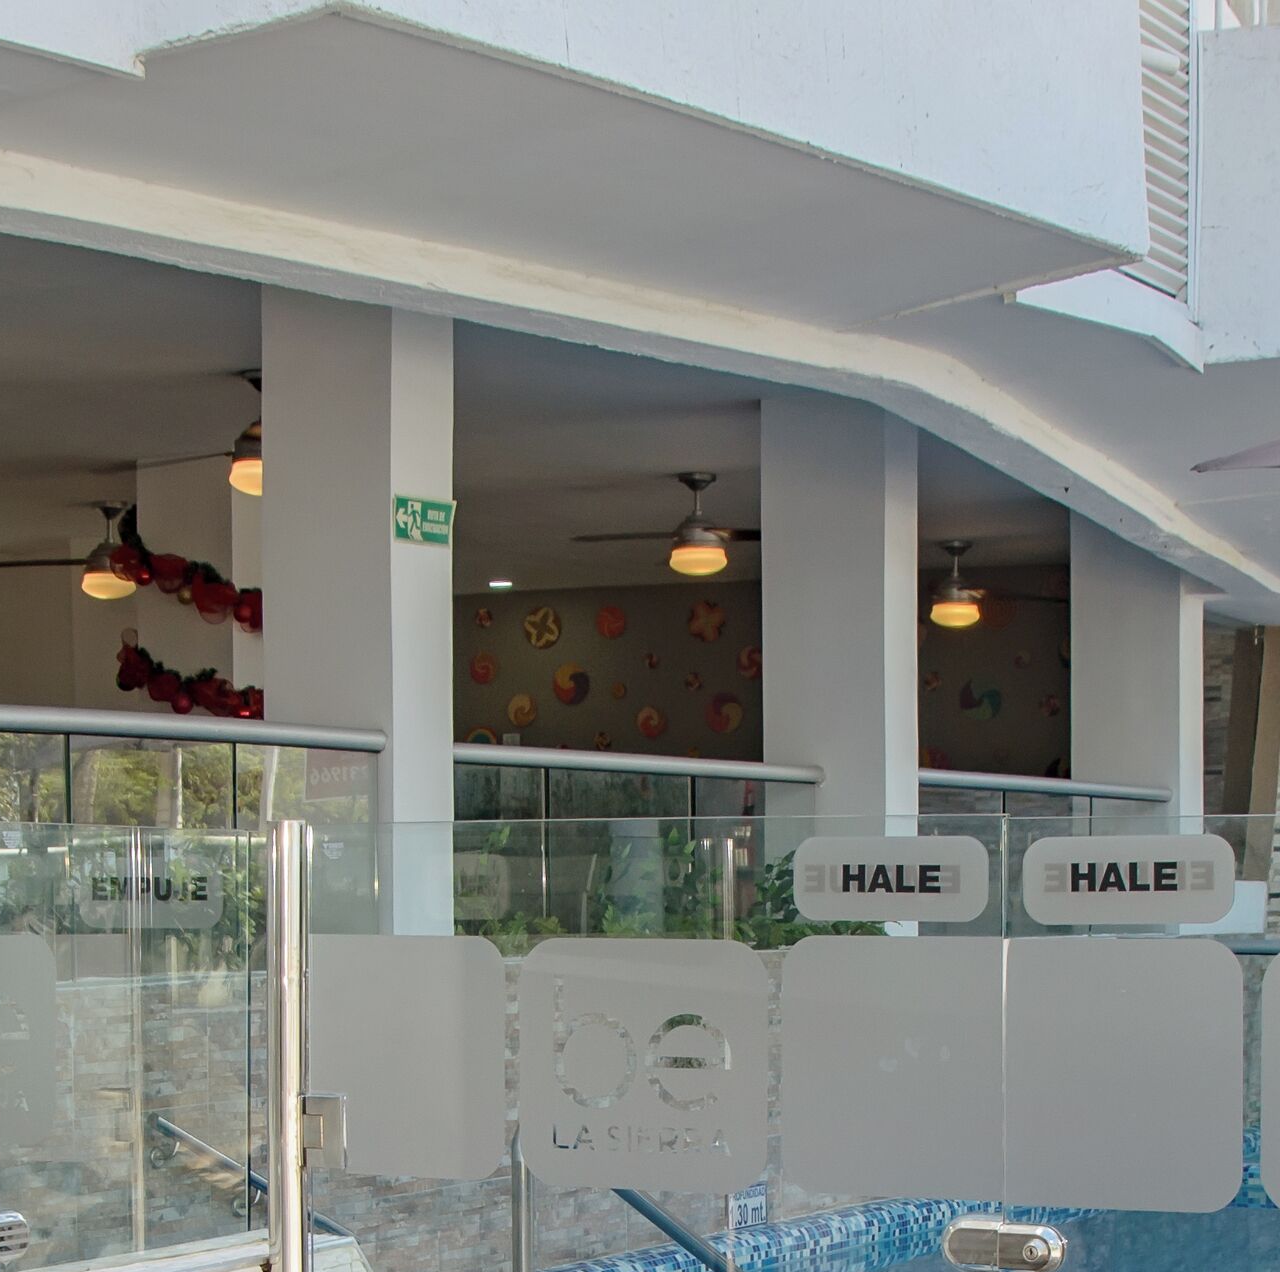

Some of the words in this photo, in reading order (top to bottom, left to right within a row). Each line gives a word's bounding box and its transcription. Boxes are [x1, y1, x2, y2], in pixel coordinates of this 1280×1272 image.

[91, 876, 208, 900] EMPUJE
[842, 864, 941, 893] HALE
[1070, 861, 1178, 892] HALE
[553, 975, 732, 1112] be
[553, 1124, 595, 1150] LA
[729, 1203, 748, 1227] 1.30
